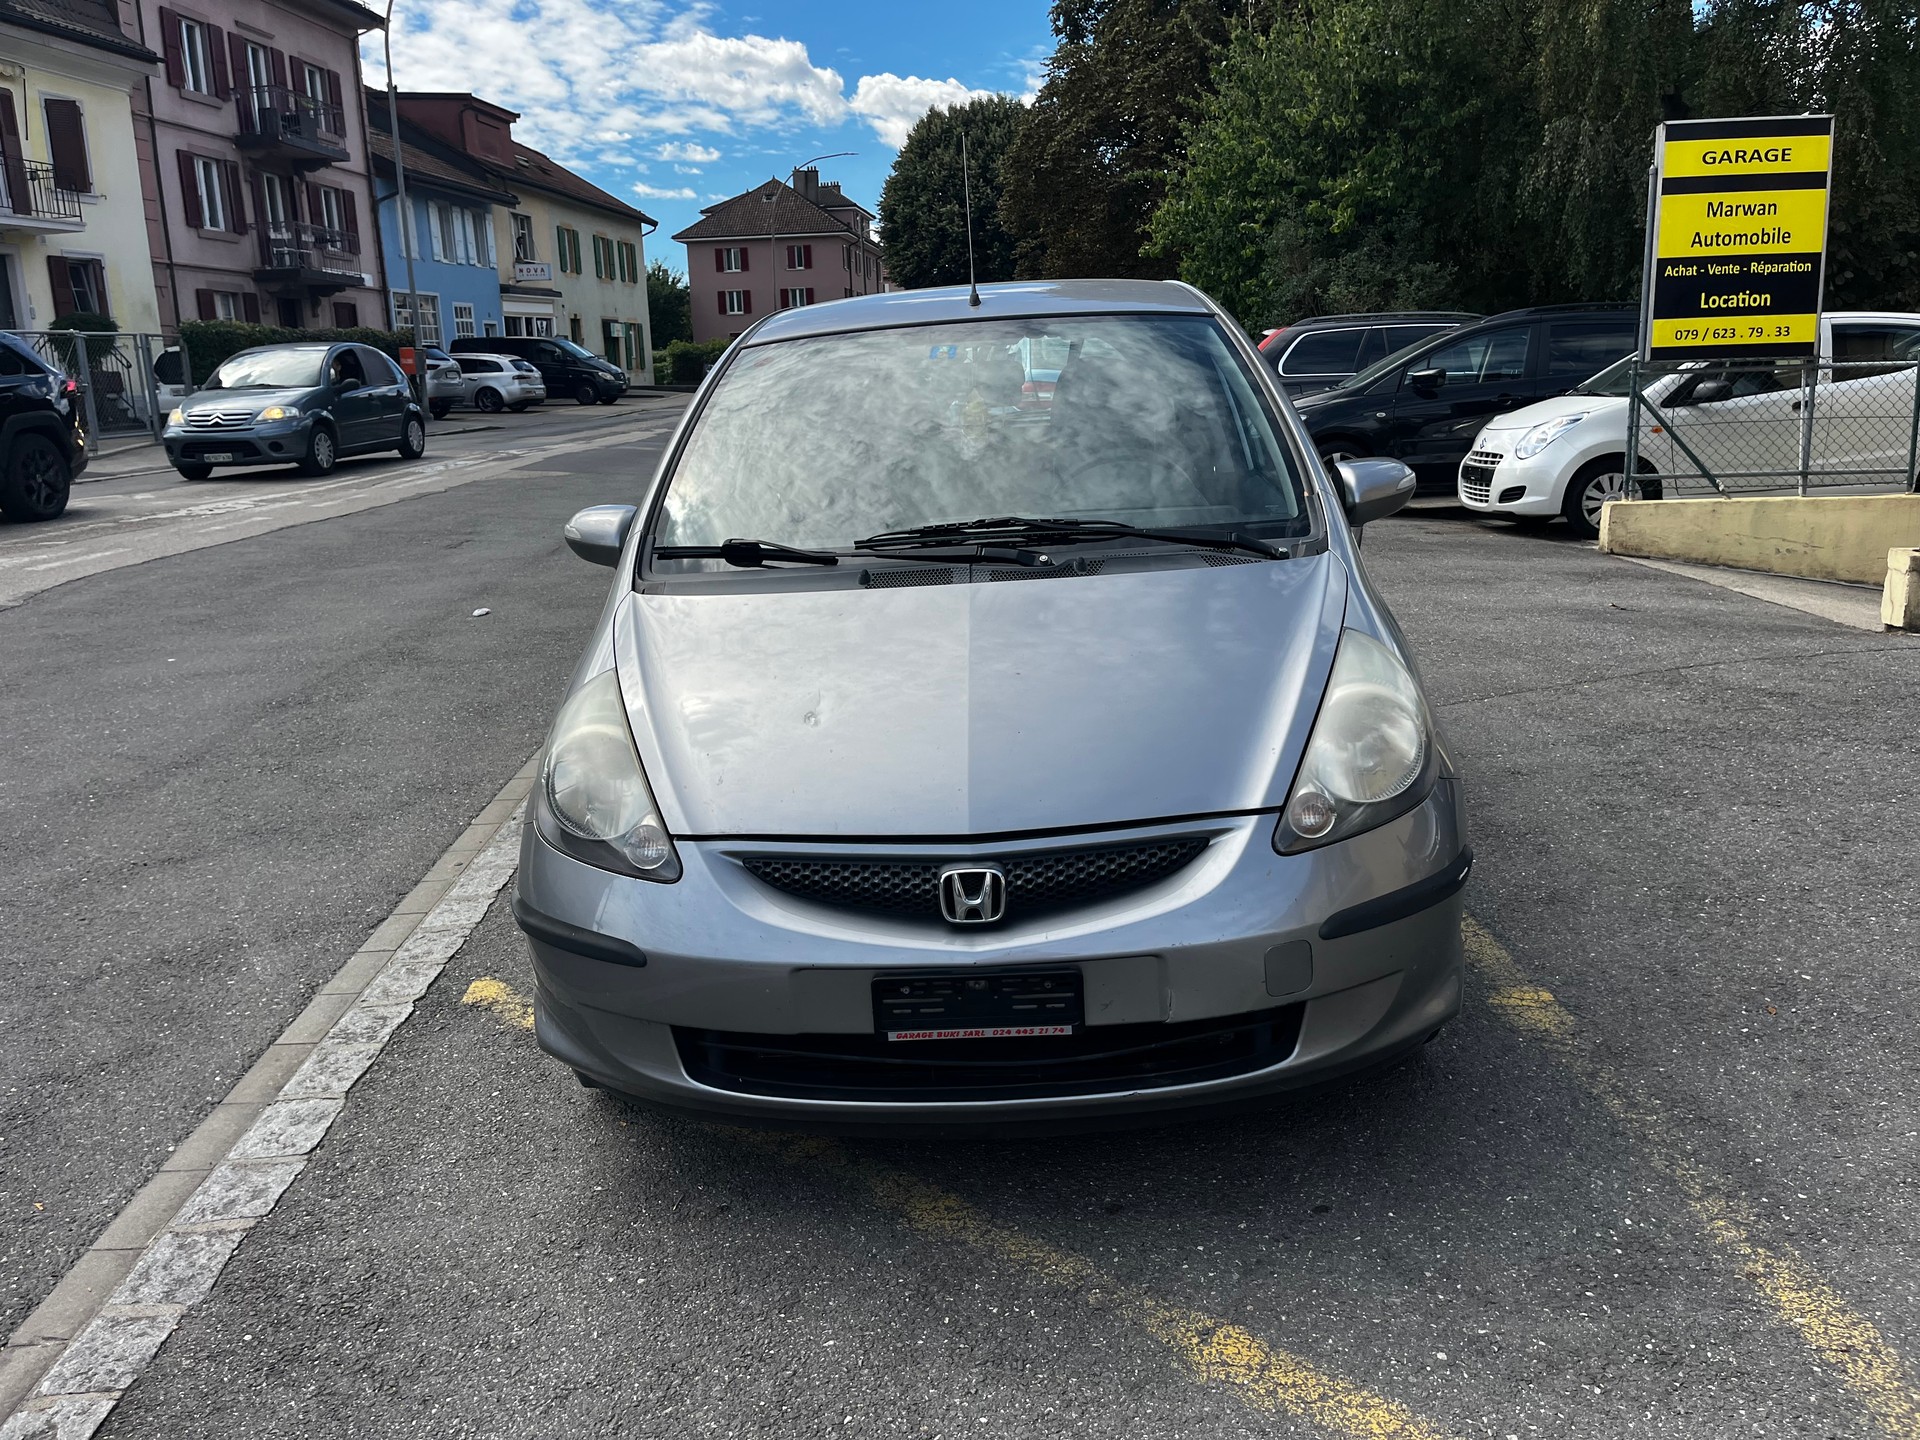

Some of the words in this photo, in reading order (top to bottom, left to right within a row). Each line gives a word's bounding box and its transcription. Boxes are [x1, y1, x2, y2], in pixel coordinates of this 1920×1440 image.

[1701, 147, 1792, 165] GARAGE
[1706, 201, 1778, 218] Marwan
[1690, 226, 1791, 248] Automobile
[1664, 263, 1698, 277] Achat
[1707, 262, 1740, 275] Vente
[1750, 260, 1812, 276] Réparation
[1700, 290, 1771, 309] Location
[1674, 328, 1699, 341] 079
[1712, 327, 1736, 340] 623
[1748, 326, 1764, 338] 79
[1774, 325, 1791, 337] 33
[896, 1031, 934, 1040] GARAGE
